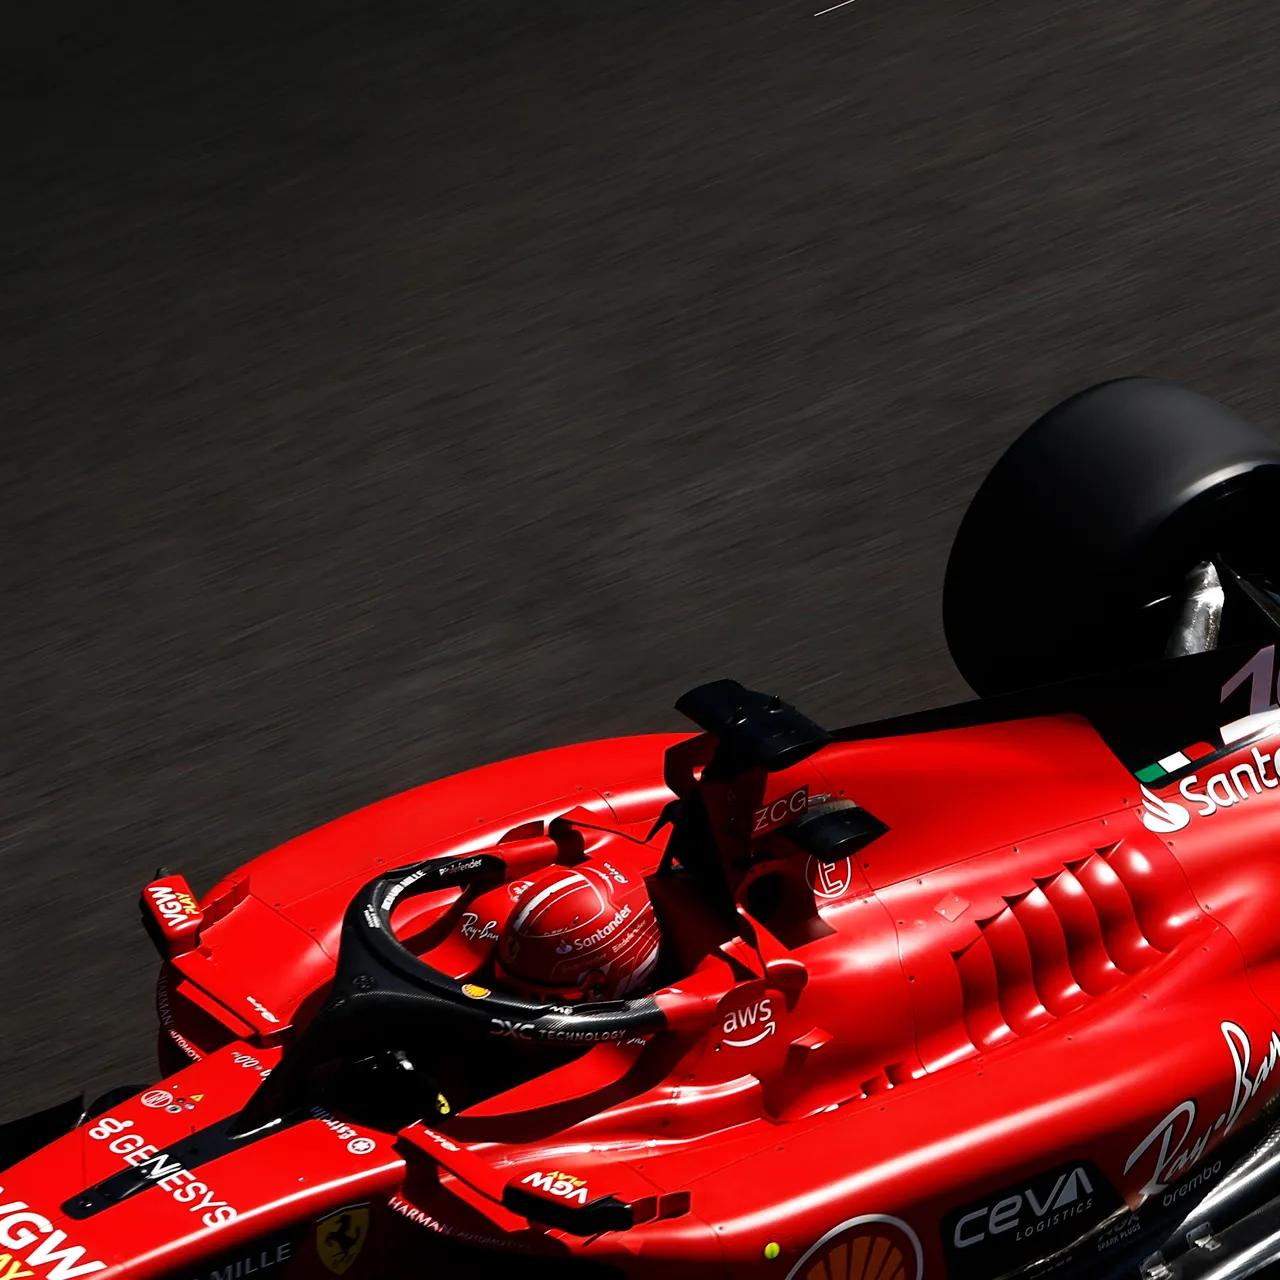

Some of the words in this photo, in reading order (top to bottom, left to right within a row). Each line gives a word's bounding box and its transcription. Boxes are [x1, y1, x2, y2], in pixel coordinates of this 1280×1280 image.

[148, 886, 189, 927] VGW
[574, 904, 632, 951] Santander
[539, 1029, 626, 1042] TECHNOLOGY
[723, 999, 772, 1034] aws
[109, 1133, 238, 1230] GENESYS
[520, 1171, 590, 1205] VGW
[1163, 1160, 1222, 1208] brembo
[387, 1196, 451, 1235] HARMAN
[1016, 1199, 1094, 1242] LOGISTICS
